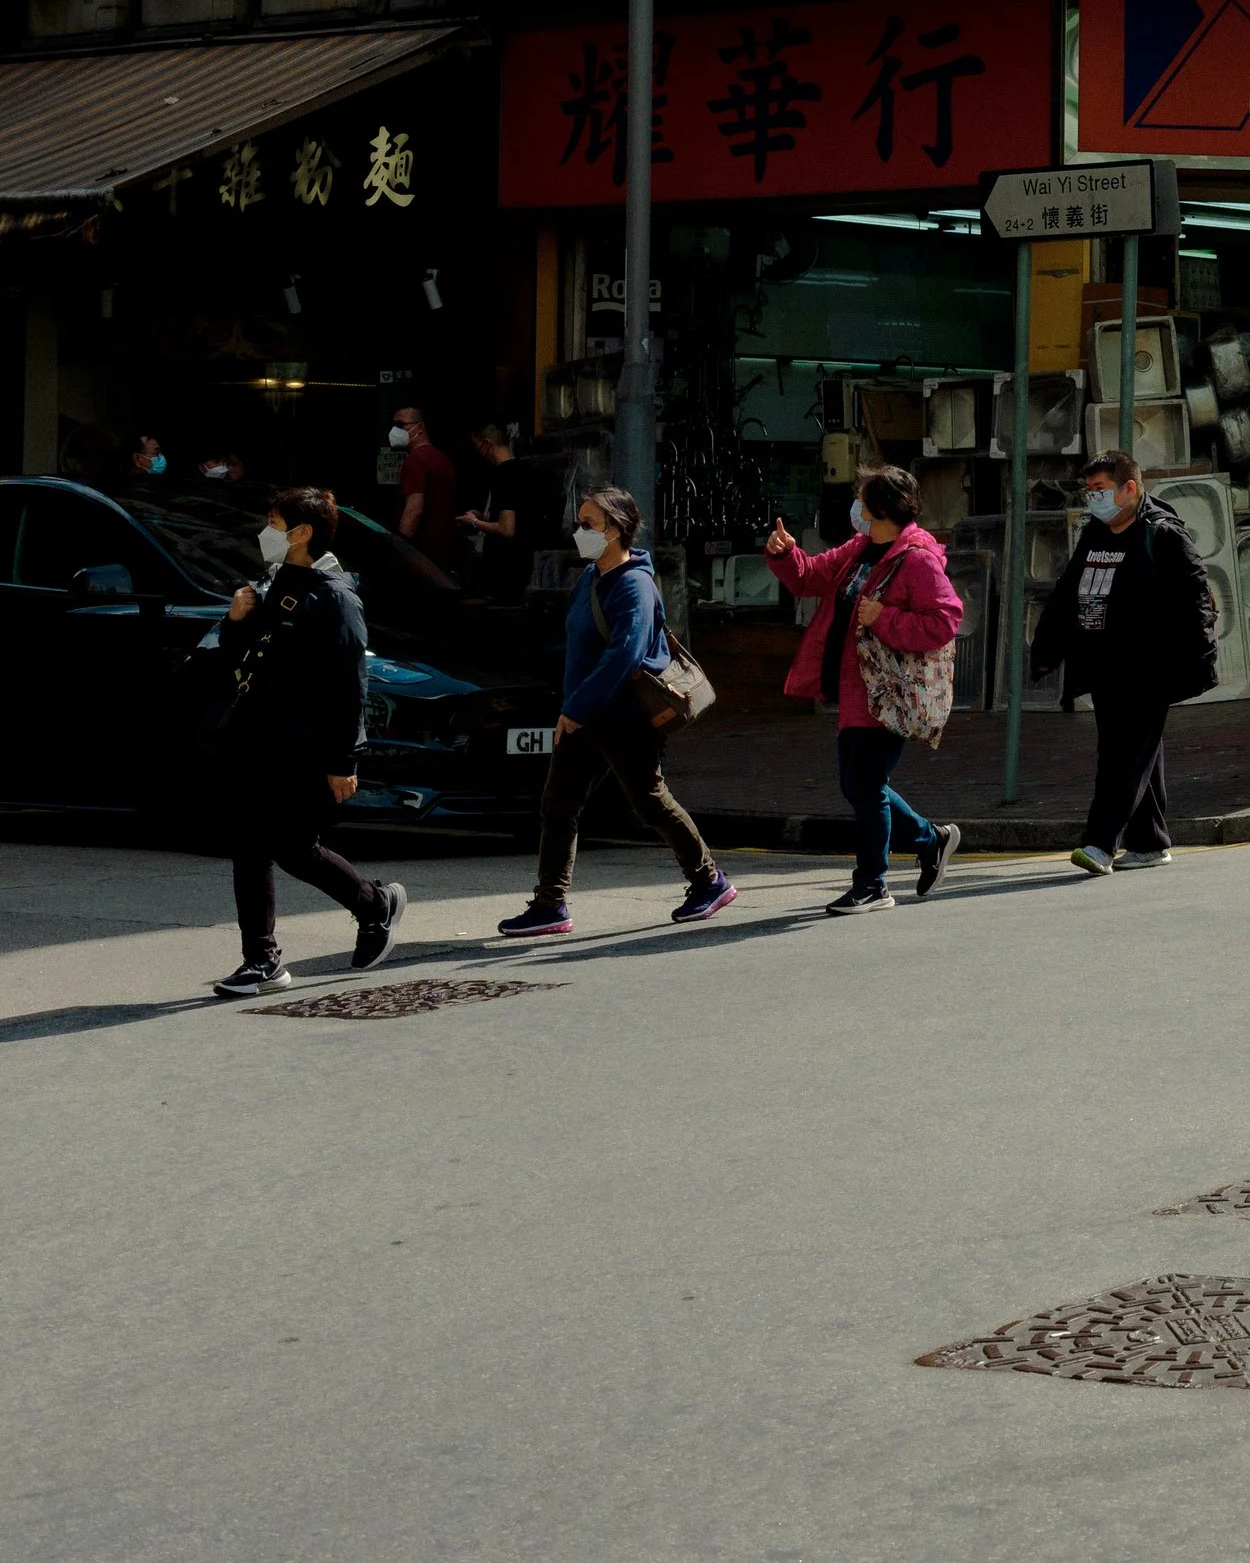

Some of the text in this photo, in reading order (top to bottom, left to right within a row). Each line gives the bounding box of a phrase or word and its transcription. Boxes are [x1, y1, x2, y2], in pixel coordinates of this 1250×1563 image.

[558, 15, 986, 187] 耀華行
[1022, 173, 1126, 196] Wai Yi Street
[1042, 204, 1109, 230] 懷義街
[591, 273, 663, 300] Roa
[516, 731, 543, 752] GH
